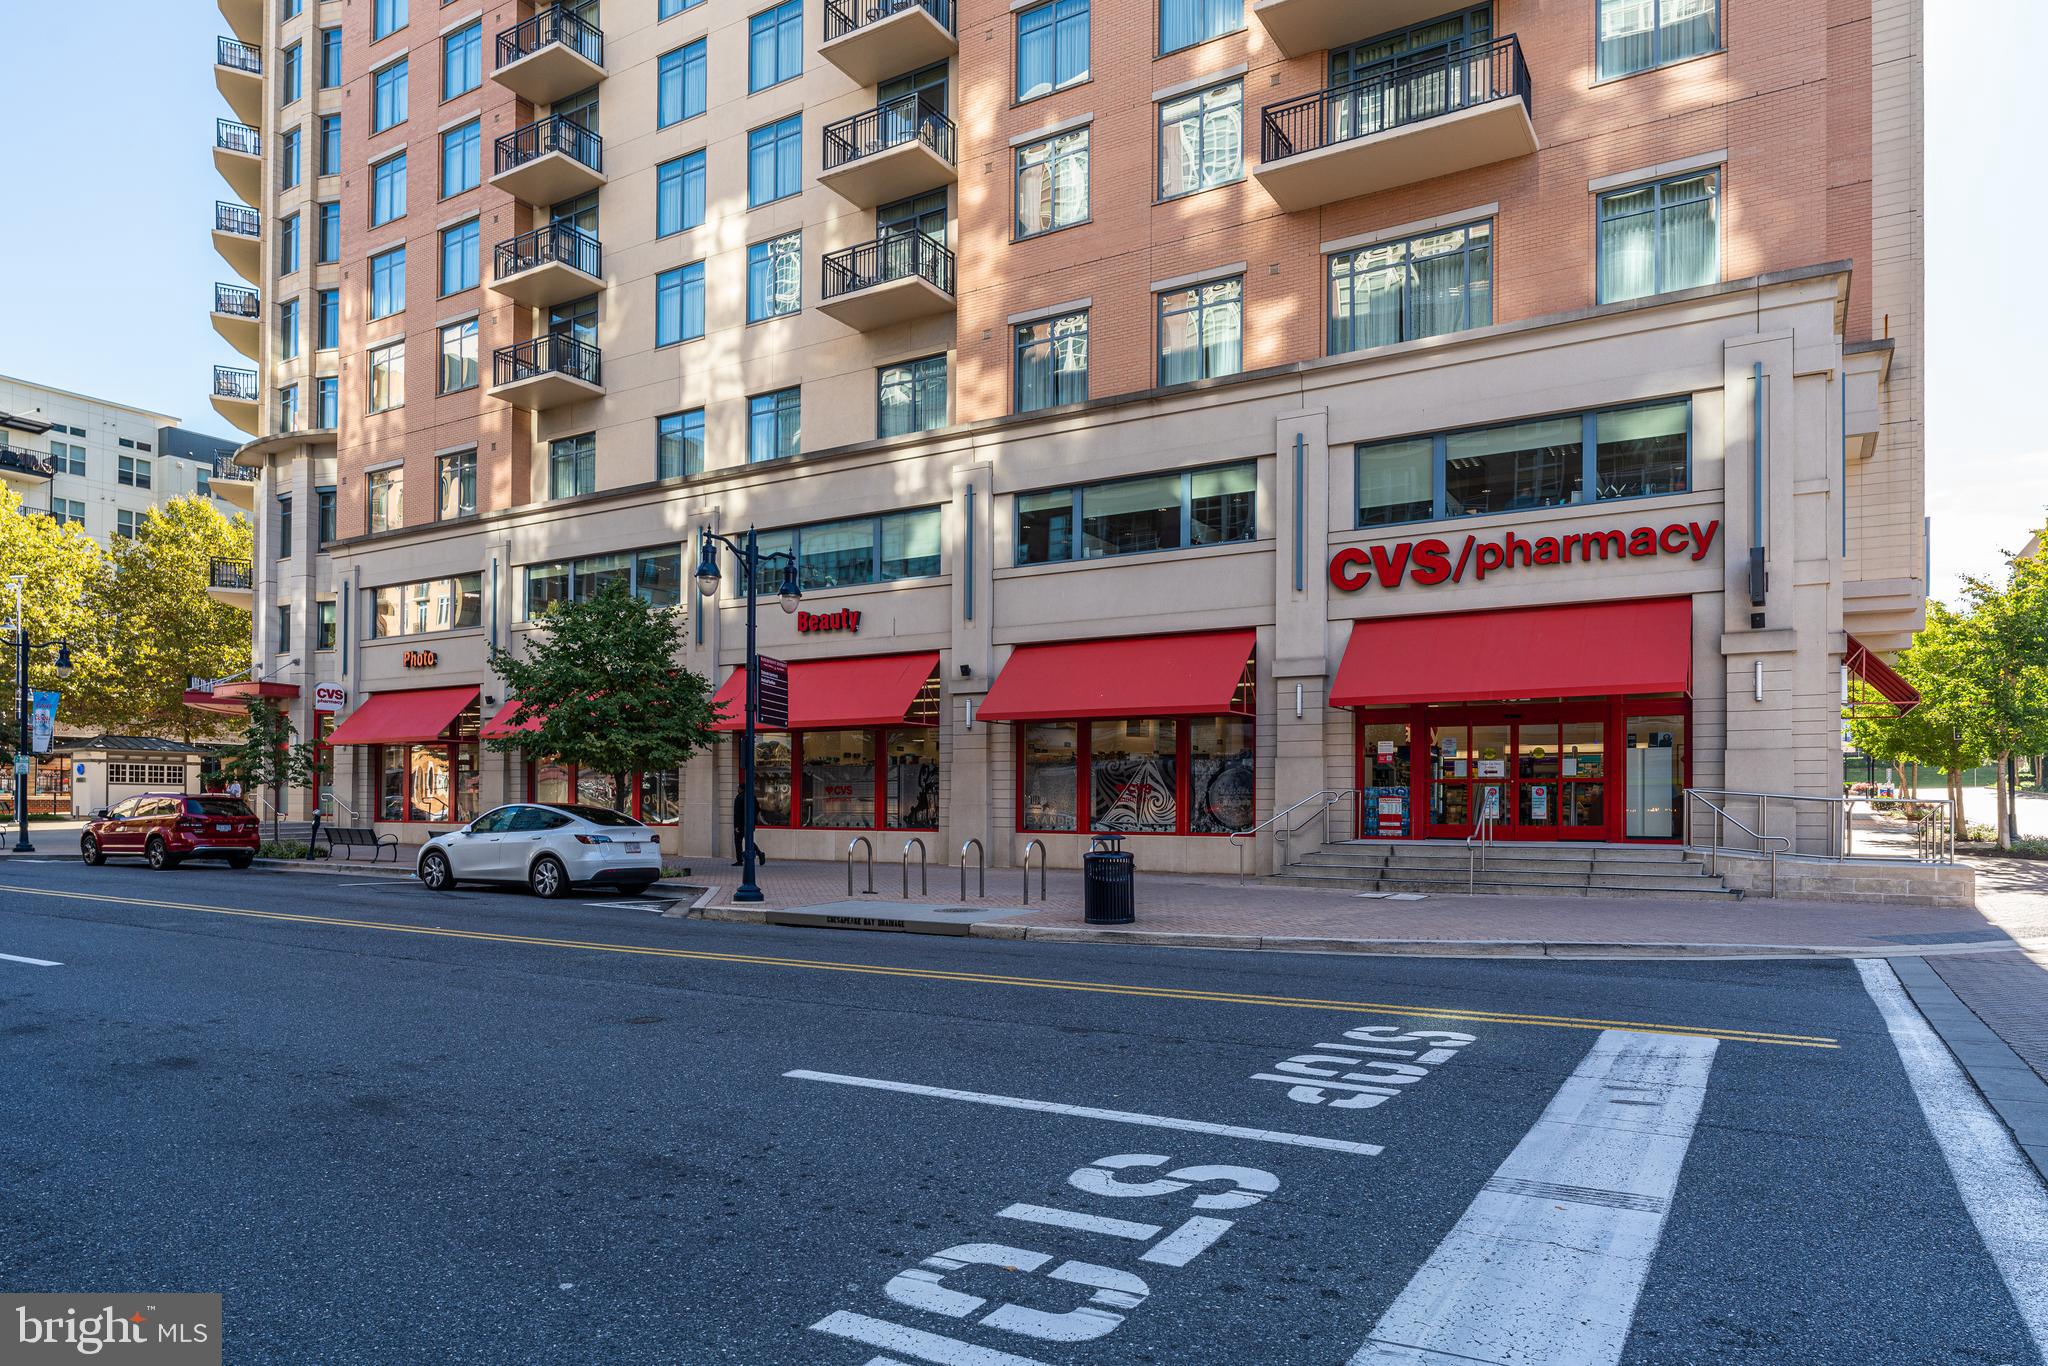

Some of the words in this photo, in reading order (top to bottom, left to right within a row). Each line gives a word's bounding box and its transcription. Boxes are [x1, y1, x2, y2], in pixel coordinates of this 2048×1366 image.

[1329, 520, 1720, 592] CVS/pharmacy
[798, 608, 861, 633] Beauty
[403, 650, 436, 668] Photo
[316, 688, 344, 700] CVS
[833, 785, 853, 796] CVS
[863, 917, 876, 927] BAY
[878, 918, 905, 929] DRAINAGE
